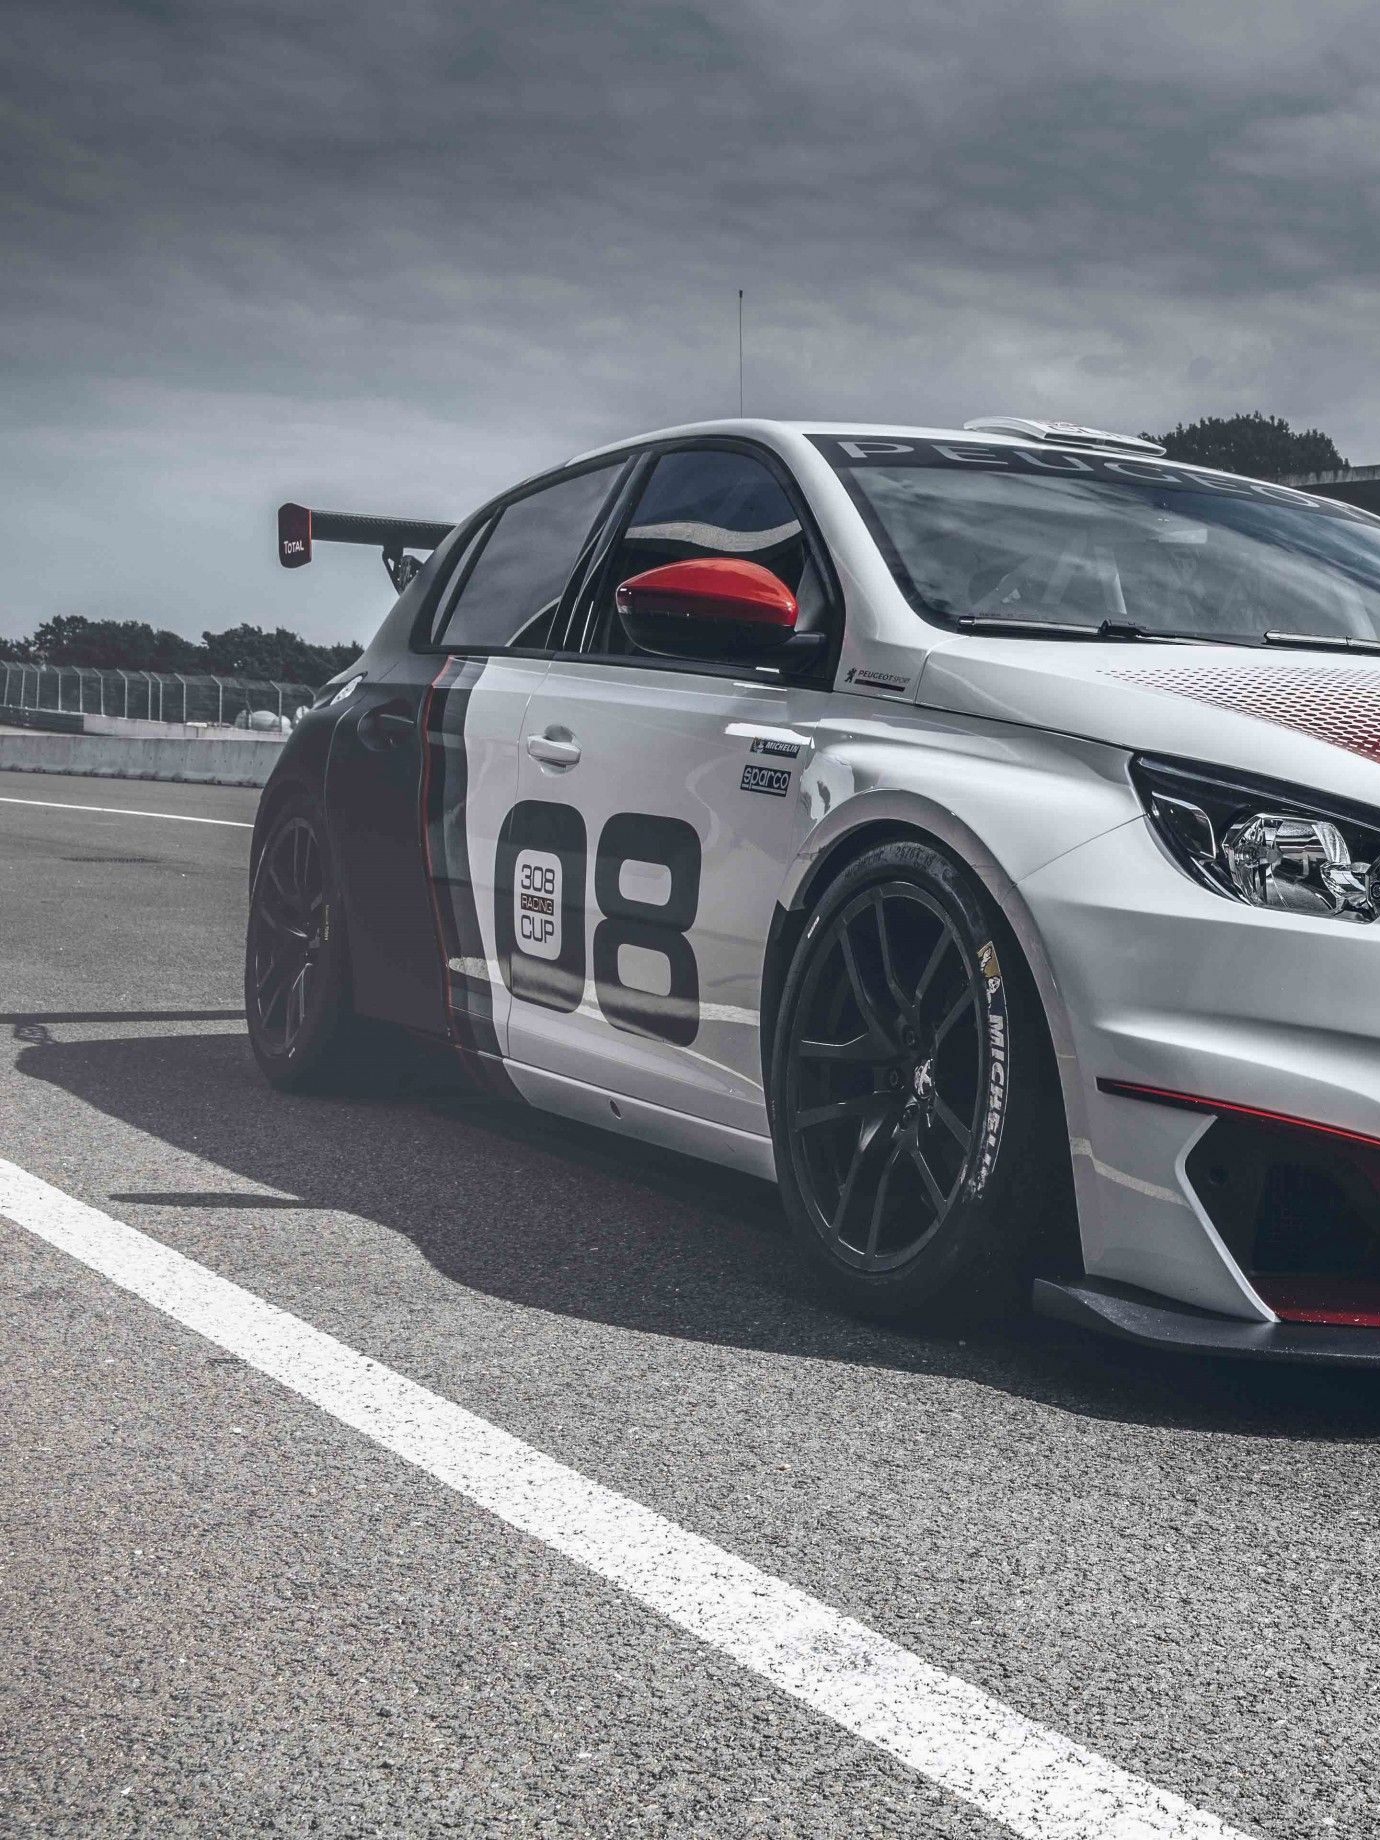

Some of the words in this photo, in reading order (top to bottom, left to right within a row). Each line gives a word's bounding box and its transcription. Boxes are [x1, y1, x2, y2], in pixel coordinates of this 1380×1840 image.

[284, 540, 305, 555] TOTAL
[857, 669, 894, 681] PEUGEOT
[765, 741, 800, 753] MICHELIN
[743, 767, 790, 790] sparco
[521, 864, 555, 895] 308
[521, 896, 554, 915] RACING
[494, 800, 702, 1047] 08
[521, 915, 554, 944] CUP
